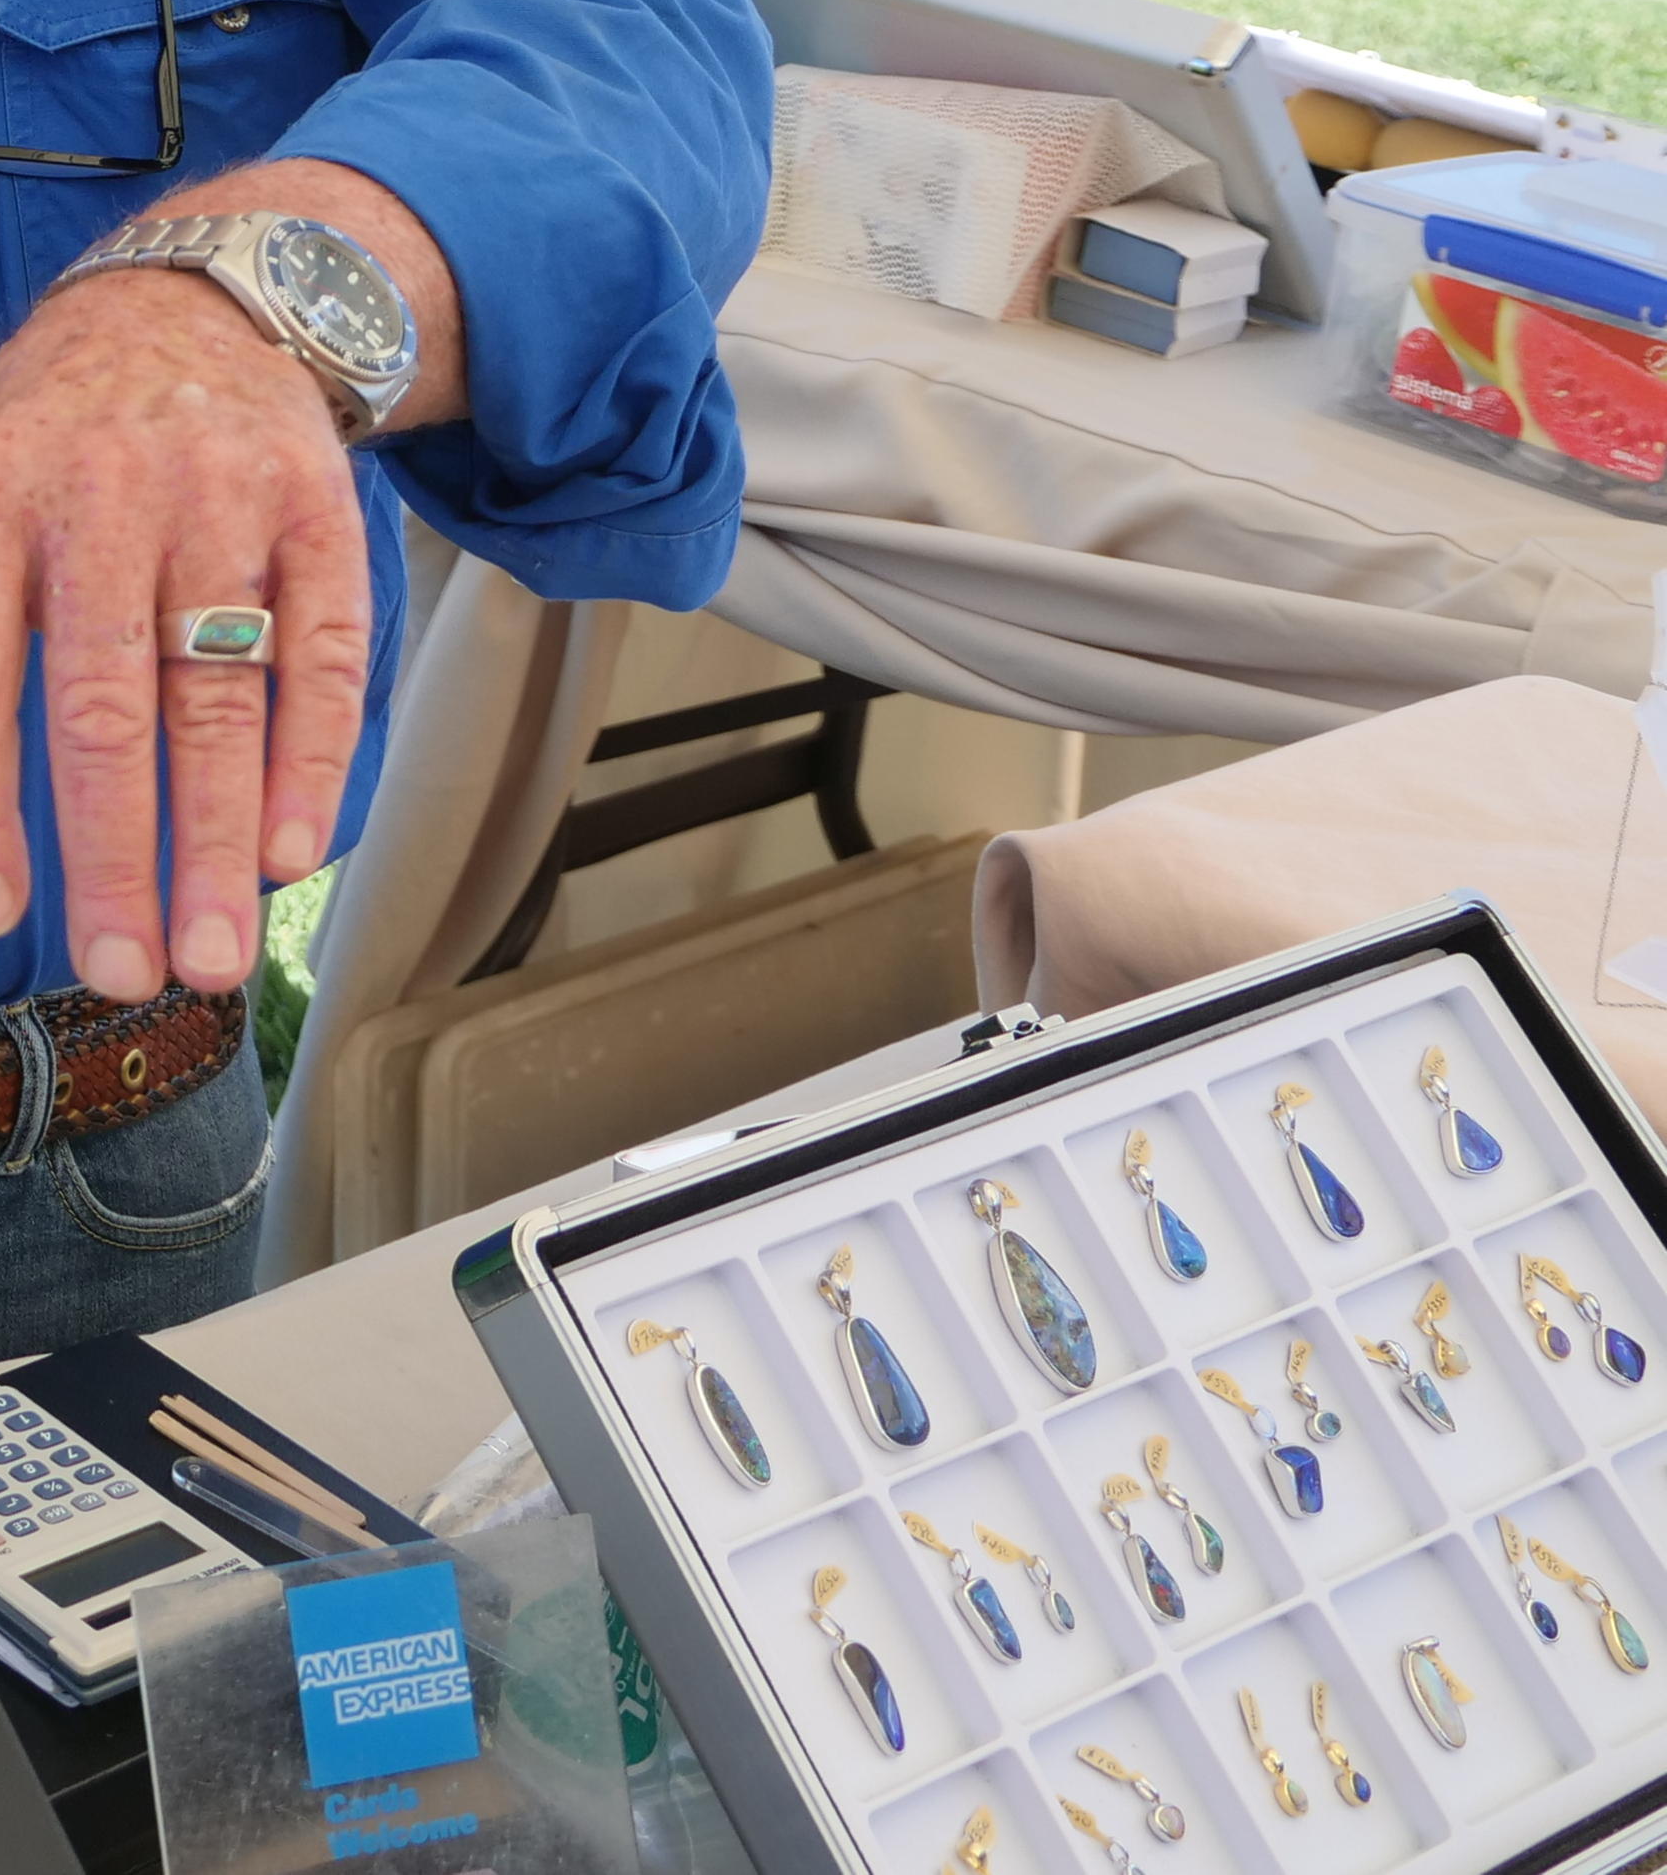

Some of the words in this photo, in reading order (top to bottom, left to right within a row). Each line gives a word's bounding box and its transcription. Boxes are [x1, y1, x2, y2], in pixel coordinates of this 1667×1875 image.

[1390, 374, 1474, 411] sistema
[19, 1414, 31, 1425] 1
[39, 1432, 53, 1442] 4
[0, 1445, 13, 1458] 5
[67, 1448, 79, 1460] 7
[22, 1463, 37, 1475] 8
[12, 1520, 31, 1532] CE
[298, 1628, 459, 1690] AMERICAN
[333, 1666, 472, 1725] EXPRESS
[323, 1783, 419, 1824] Cards
[327, 1813, 480, 1861] Welcome
